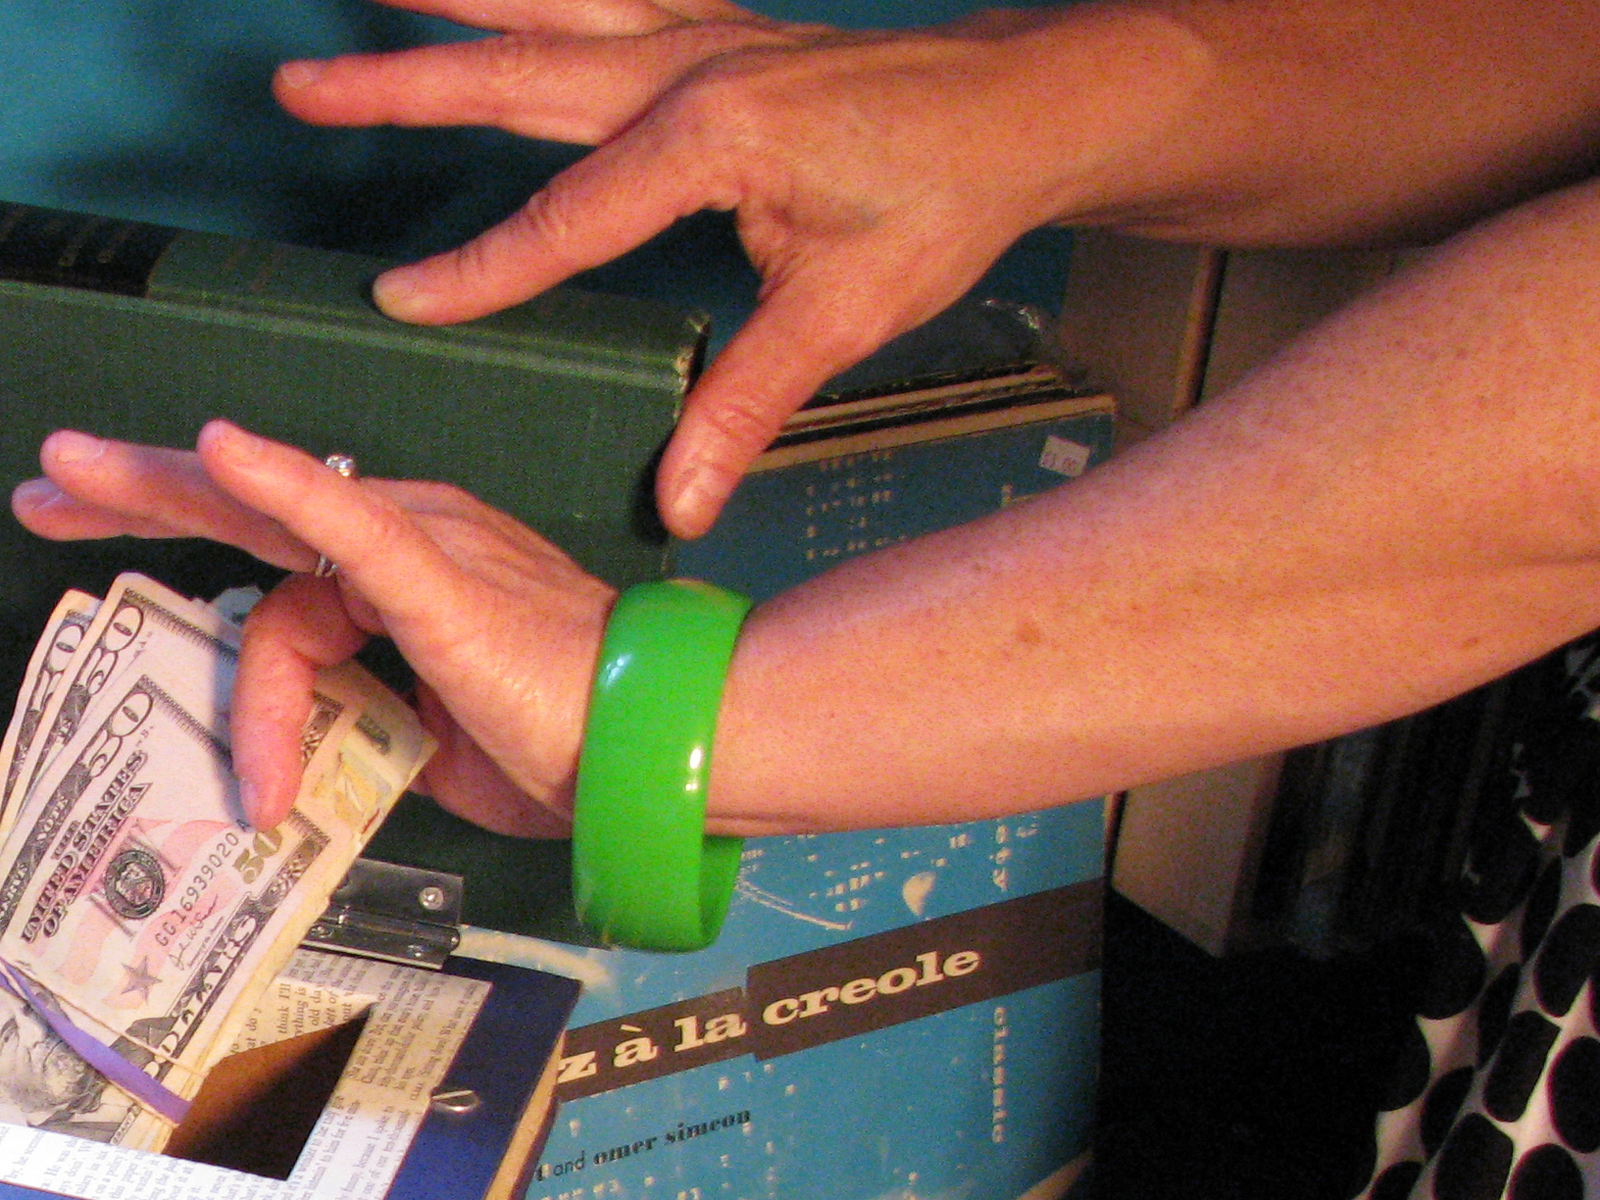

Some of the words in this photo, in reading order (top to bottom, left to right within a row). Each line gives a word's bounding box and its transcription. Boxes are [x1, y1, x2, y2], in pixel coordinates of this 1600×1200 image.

[85, 605, 144, 696] 50
[80, 687, 155, 779] 50
[18, 851, 79, 944] UNITED
[69, 747, 149, 852] STATES
[38, 900, 70, 937] OF
[57, 776, 152, 903] AMERICA
[232, 824, 283, 883] 50
[276, 982, 293, 999] I'll
[295, 985, 307, 996] is
[614, 1024, 660, 1068] à
[674, 1010, 746, 1054] la
[763, 947, 981, 1027] creole
[245, 1017, 258, 1031] do
[271, 1005, 294, 1033] think
[305, 1008, 322, 1025] old
[554, 1150, 585, 1176] and
[593, 1132, 659, 1165] omer
